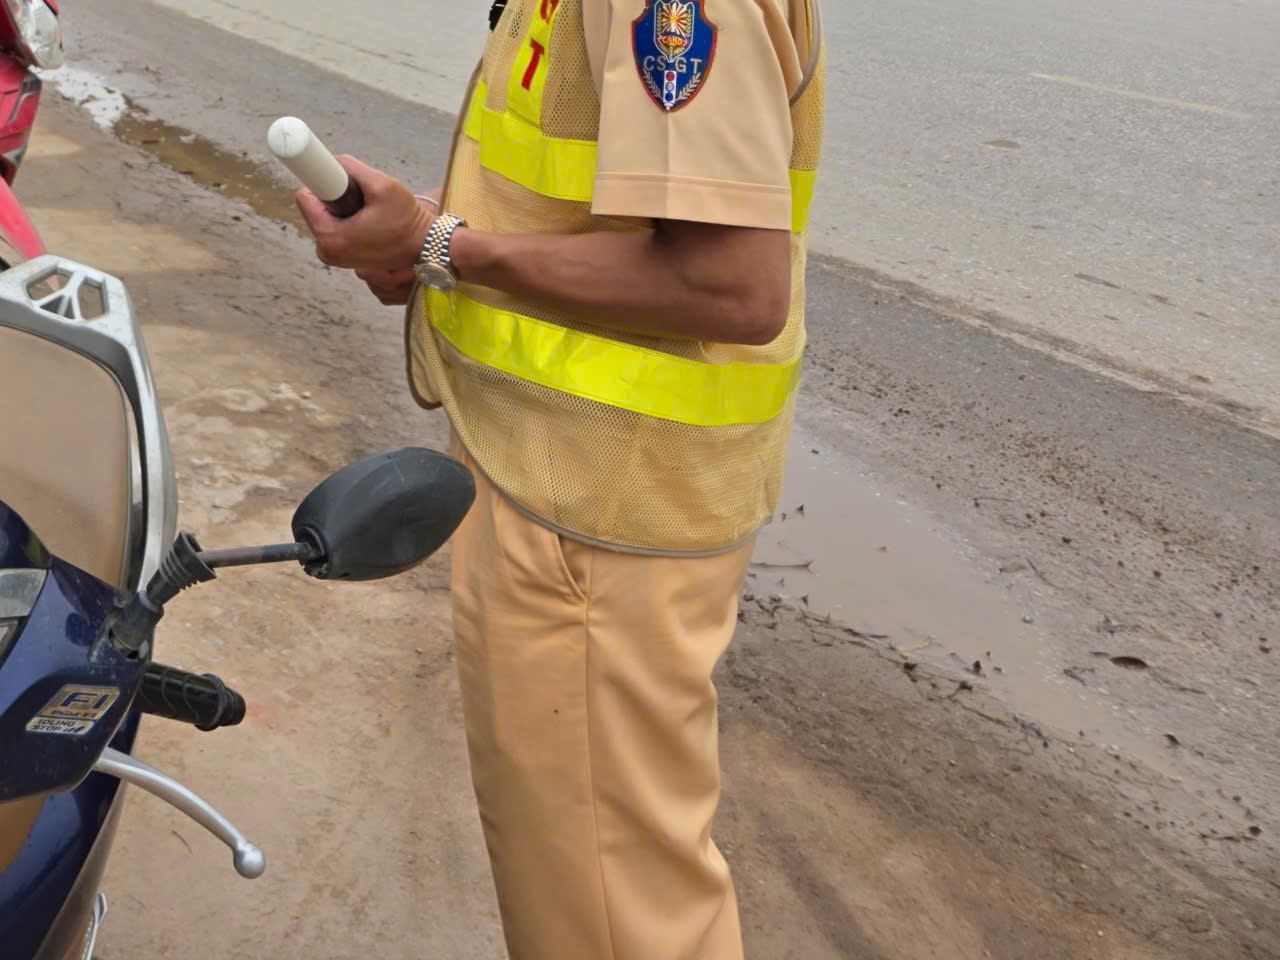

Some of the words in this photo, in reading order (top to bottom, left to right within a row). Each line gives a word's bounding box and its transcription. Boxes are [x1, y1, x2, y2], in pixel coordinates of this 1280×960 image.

[60, 691, 109, 709] FI
[38, 718, 76, 727] IDLING
[31, 723, 63, 732] STOP
